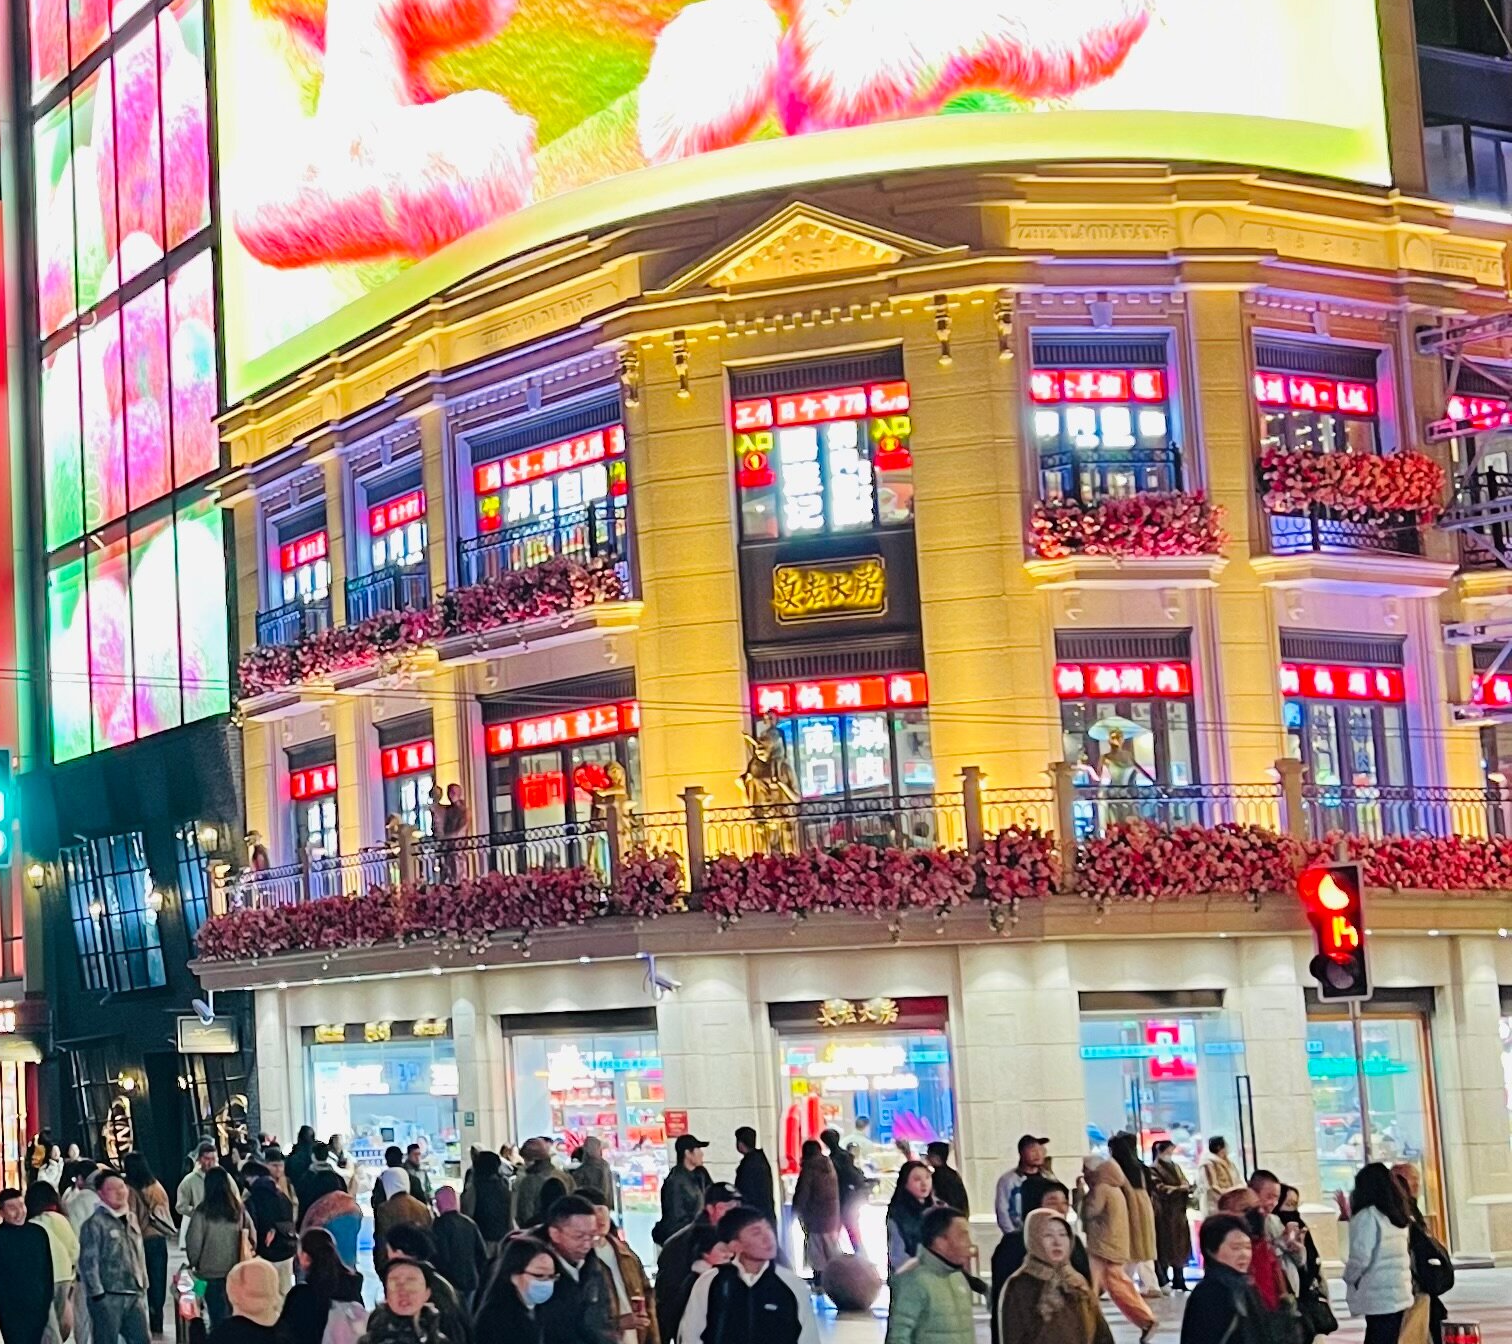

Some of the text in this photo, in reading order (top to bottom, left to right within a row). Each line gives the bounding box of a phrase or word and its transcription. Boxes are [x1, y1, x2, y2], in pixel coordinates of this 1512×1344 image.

[738, 432, 774, 455] 入口
[872, 416, 912, 439] 入口
[775, 560, 886, 610] 真老大房
[802, 722, 835, 790] 南门
